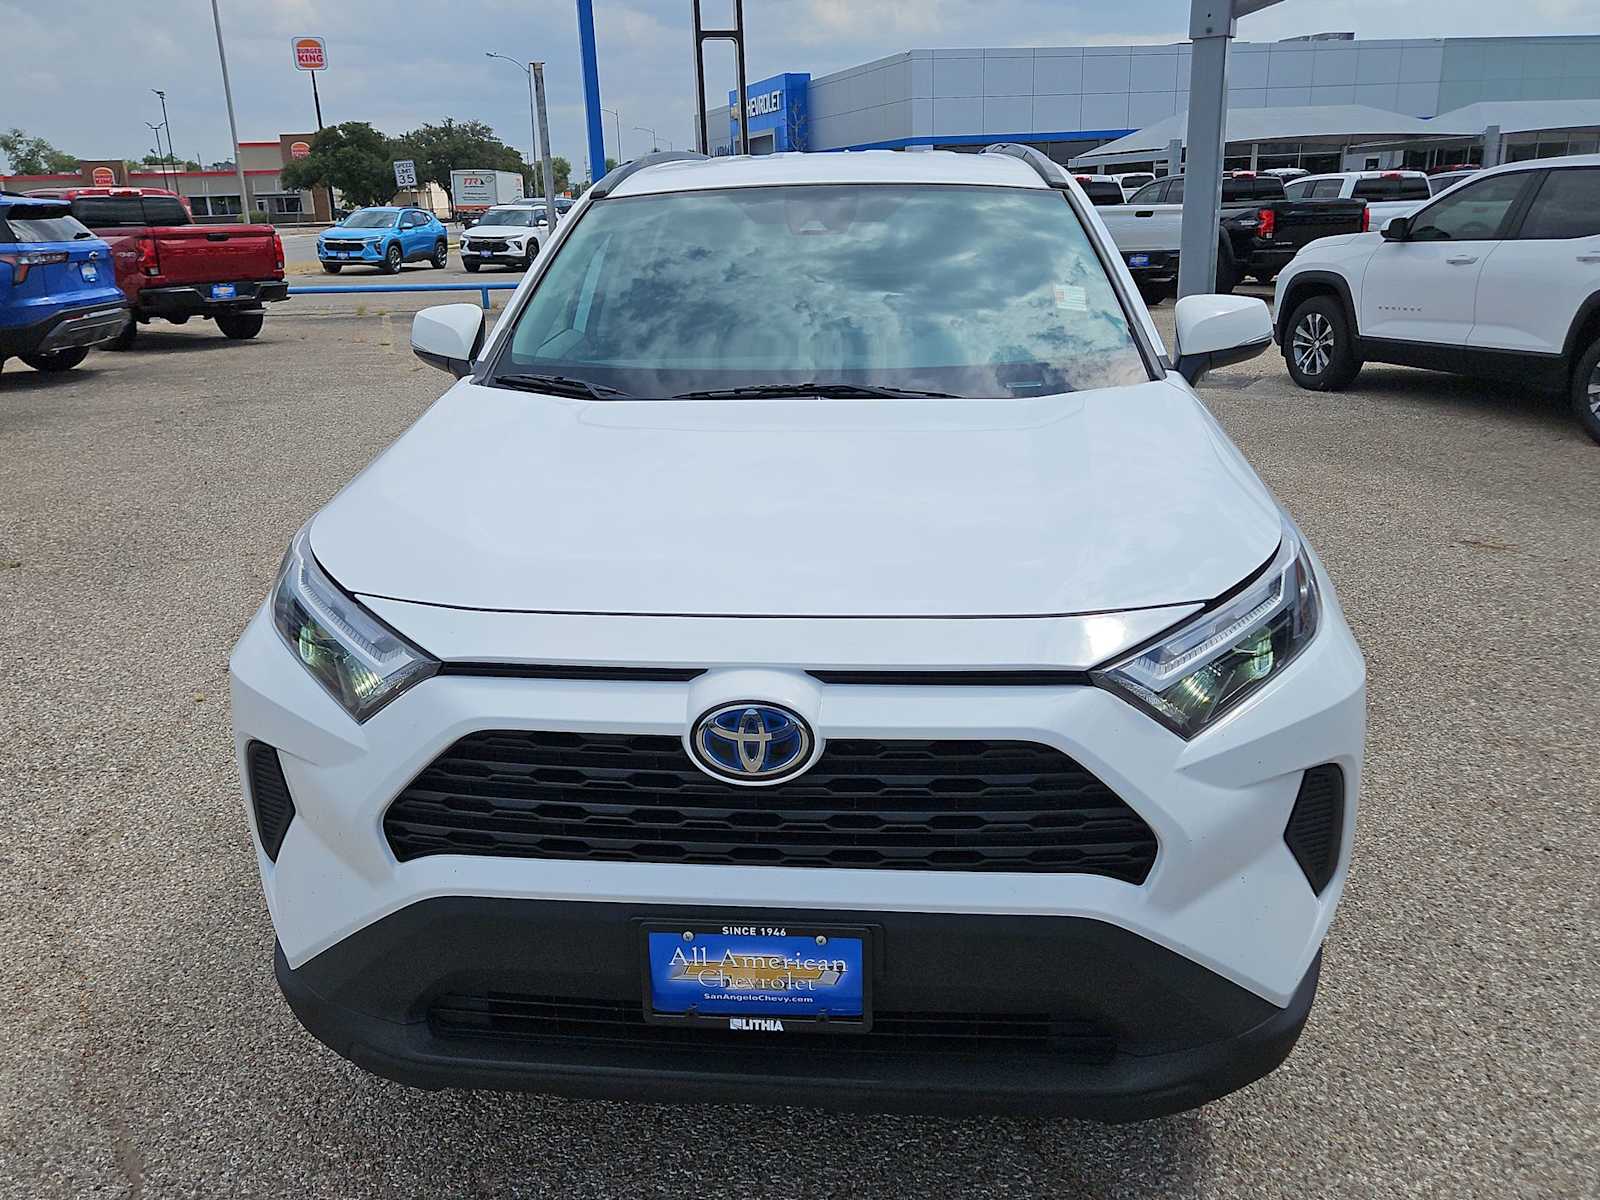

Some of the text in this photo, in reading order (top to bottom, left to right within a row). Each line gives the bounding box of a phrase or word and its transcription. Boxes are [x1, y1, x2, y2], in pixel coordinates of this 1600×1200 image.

[297, 54, 323, 62] KING
[746, 90, 782, 118] HEVROLET
[399, 174, 415, 185] 35
[722, 926, 787, 937] SINCE 1946
[668, 946, 848, 972] All American
[698, 969, 817, 991] Chevrolet
[703, 992, 814, 1004] SanAngeloChevy.com
[742, 1019, 784, 1032] LITHIA
